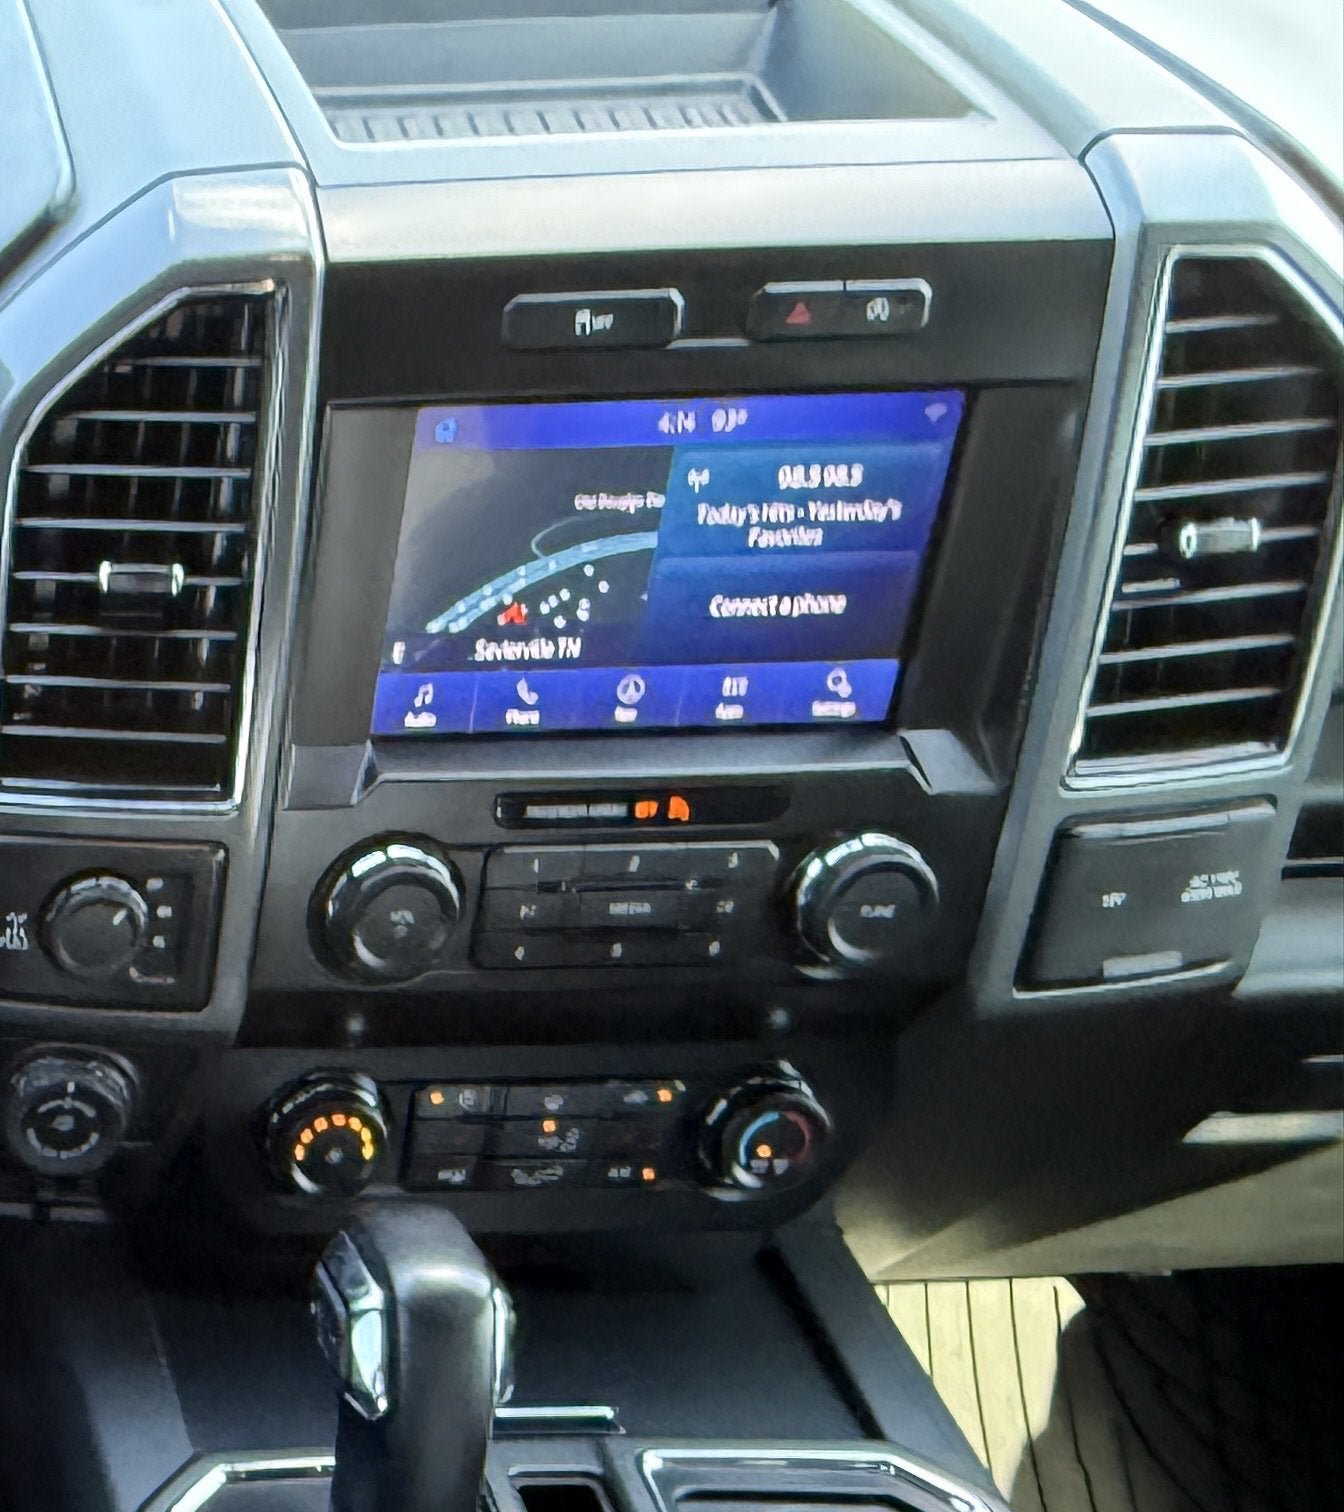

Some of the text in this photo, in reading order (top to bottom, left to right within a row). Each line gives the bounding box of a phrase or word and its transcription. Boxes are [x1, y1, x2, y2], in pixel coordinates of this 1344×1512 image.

[747, 525, 824, 548] Favorites
[708, 594, 779, 618] Connect
[792, 593, 848, 618] phone
